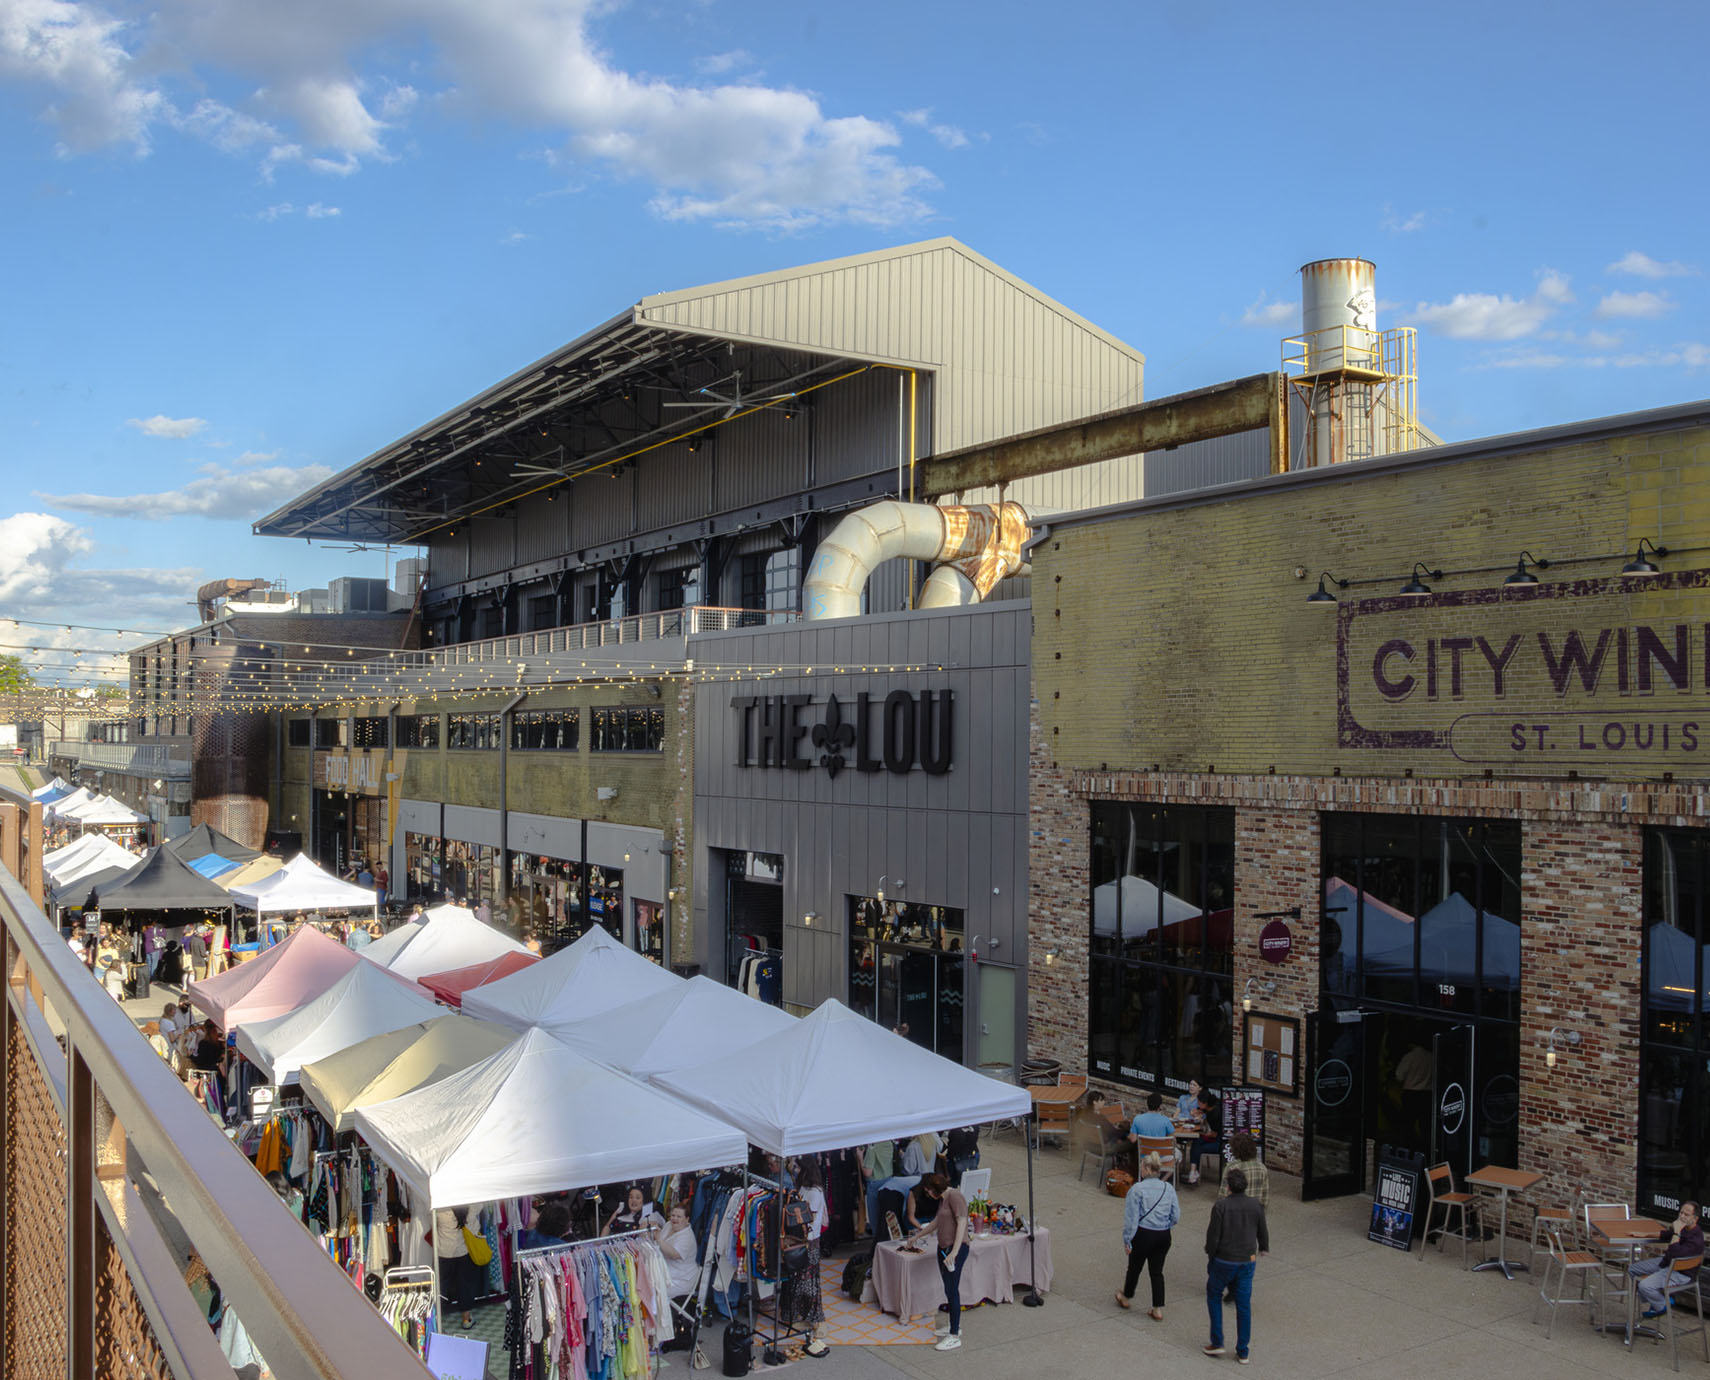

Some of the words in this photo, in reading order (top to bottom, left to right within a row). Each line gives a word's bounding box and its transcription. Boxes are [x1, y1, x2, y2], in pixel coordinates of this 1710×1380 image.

[1373, 633, 1525, 704] CITY
[730, 693, 812, 770] THE
[857, 689, 953, 775] LOU
[1511, 723, 1556, 751] ST.
[1579, 721, 1700, 751] LOUIS
[326, 756, 348, 785] FOOD
[352, 757, 378, 787] HALL
[1438, 984, 1456, 996] 158
[1096, 1060, 1110, 1071] MUSIC
[1120, 1066, 1138, 1079] PRIVATE
[1138, 1070, 1155, 1082] EVENTS
[1392, 1173, 1401, 1182] LIVE
[1381, 1179, 1411, 1204] MUSIC
[1654, 1194, 1680, 1211] MUSIC
